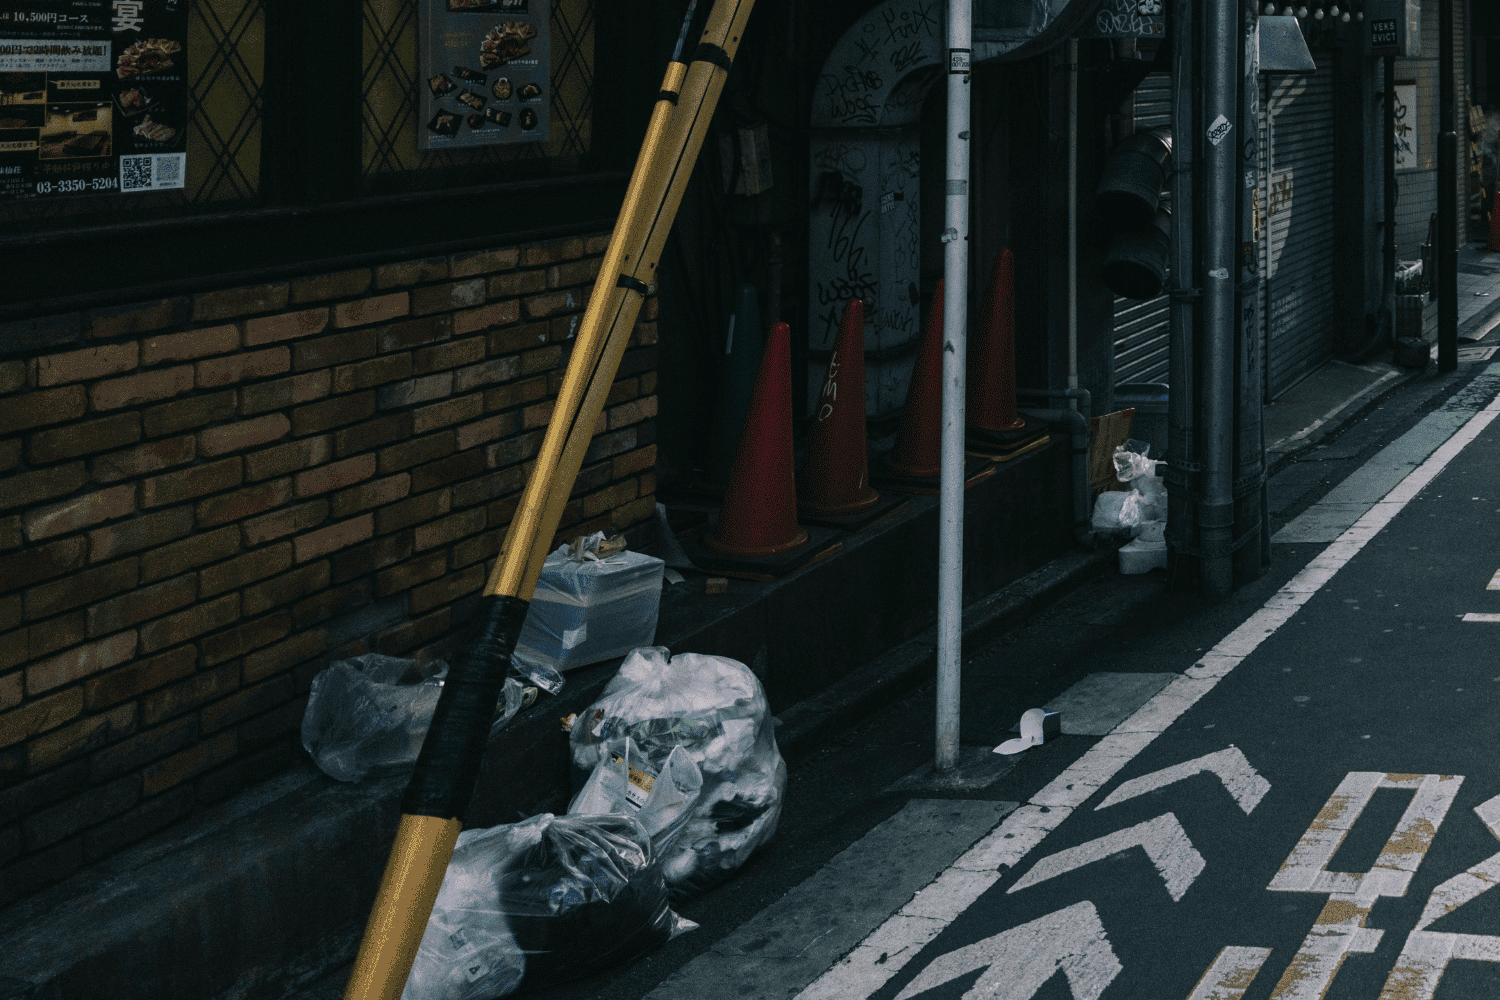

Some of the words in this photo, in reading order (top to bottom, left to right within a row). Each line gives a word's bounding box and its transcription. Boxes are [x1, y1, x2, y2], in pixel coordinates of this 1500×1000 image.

[13, 12, 89, 24] 10,500円コース
[1373, 22, 1395, 31] VEKS
[1373, 33, 1396, 42] EVICT
[36, 176, 118, 194] 03-3350-5204
